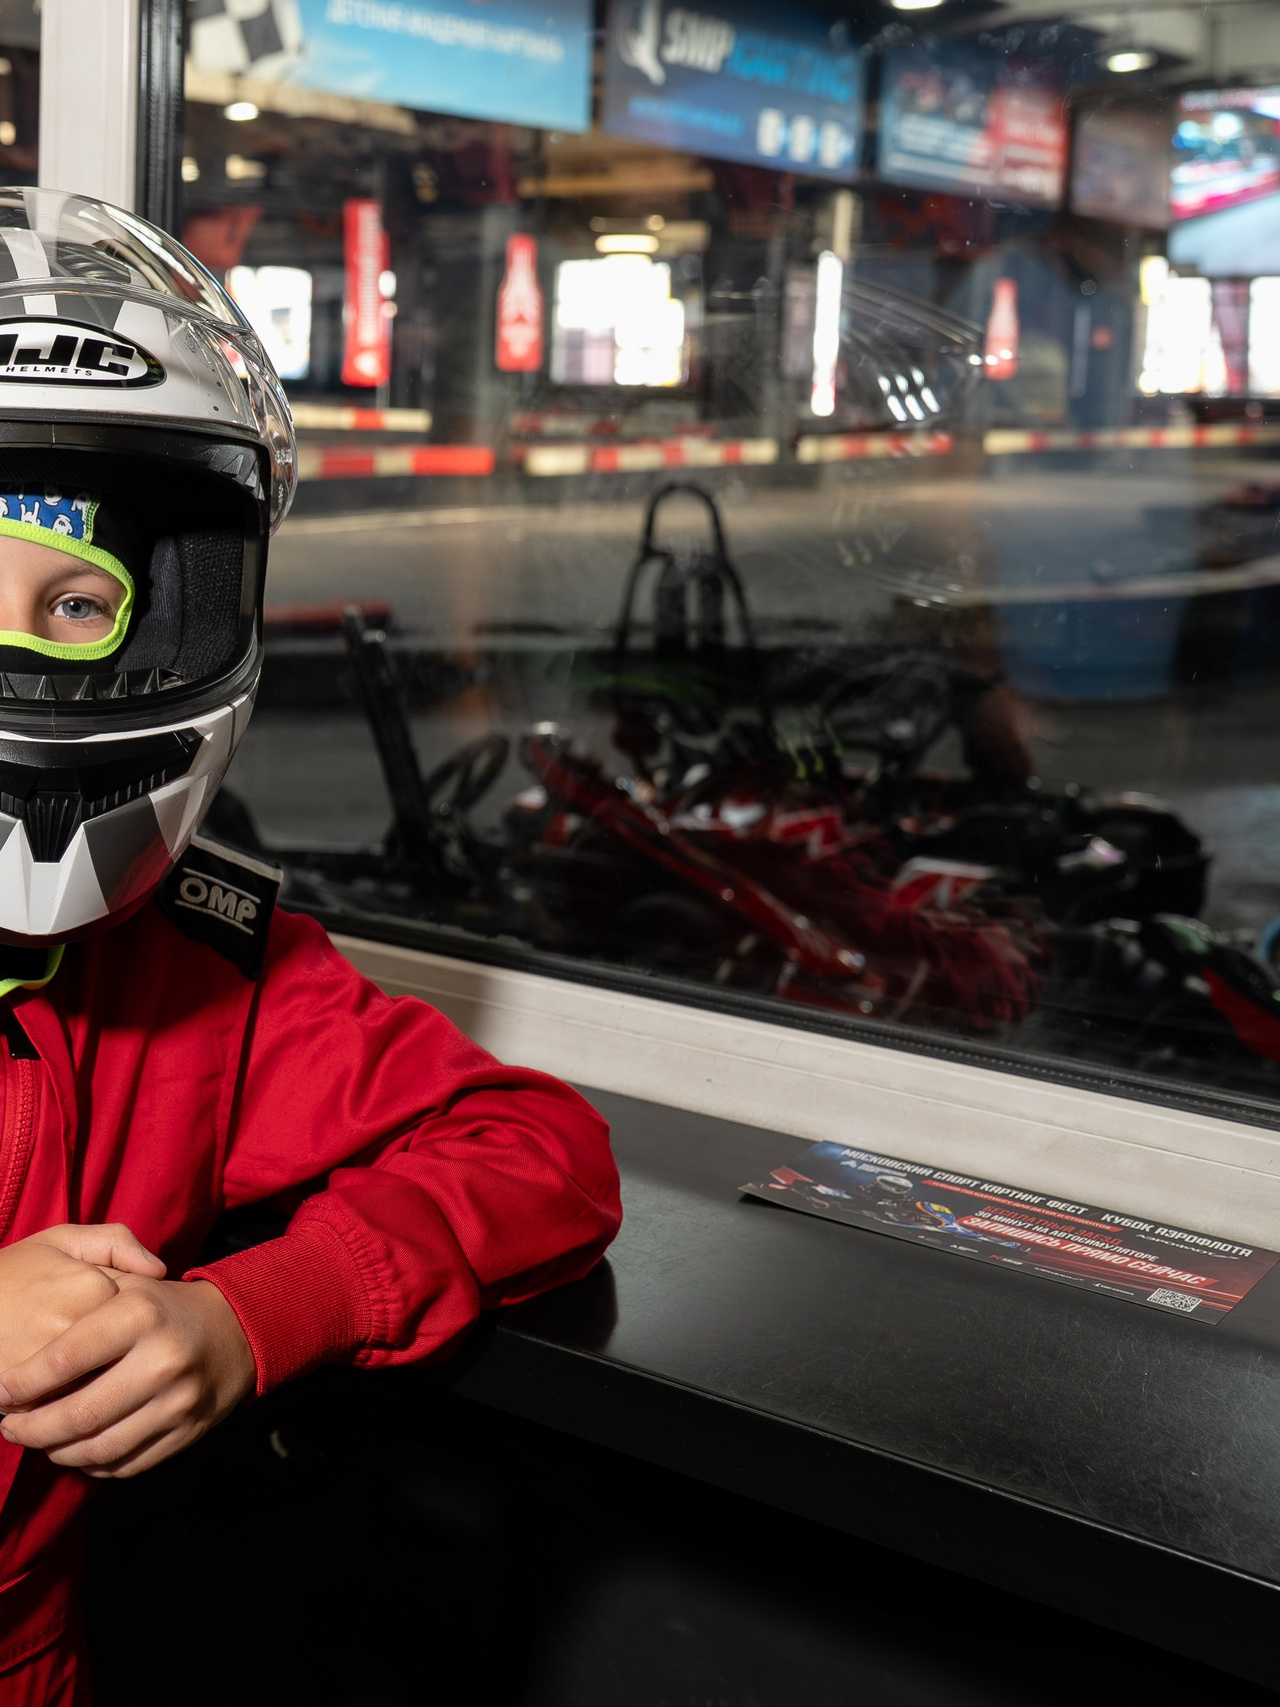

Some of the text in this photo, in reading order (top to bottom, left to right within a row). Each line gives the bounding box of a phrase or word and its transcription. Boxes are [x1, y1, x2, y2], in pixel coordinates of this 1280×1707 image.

[6, 366, 93, 376] HELMETS
[180, 877, 257, 922] OMP
[841, 1149, 933, 1176] МОСКОВСКИЙ
[932, 1172, 981, 1187] СПОРТ
[979, 1183, 1047, 1204] КАРТИНГ
[1045, 1199, 1089, 1214] ФЕСТ
[1101, 1213, 1156, 1232] КУБОК
[1154, 1226, 1253, 1258] АЭРОФЛОТА
[982, 1205, 1122, 1246] БЕСПЛАТНЫЙ ЗАЕЗД
[963, 1217, 1207, 1285] ЗАПИШИСЬ ПРЯМО СЕЙЧАС
[975, 1210, 1159, 1262] 30 МИНУТ НА АВТОСИМУЛЯТОРЕ
